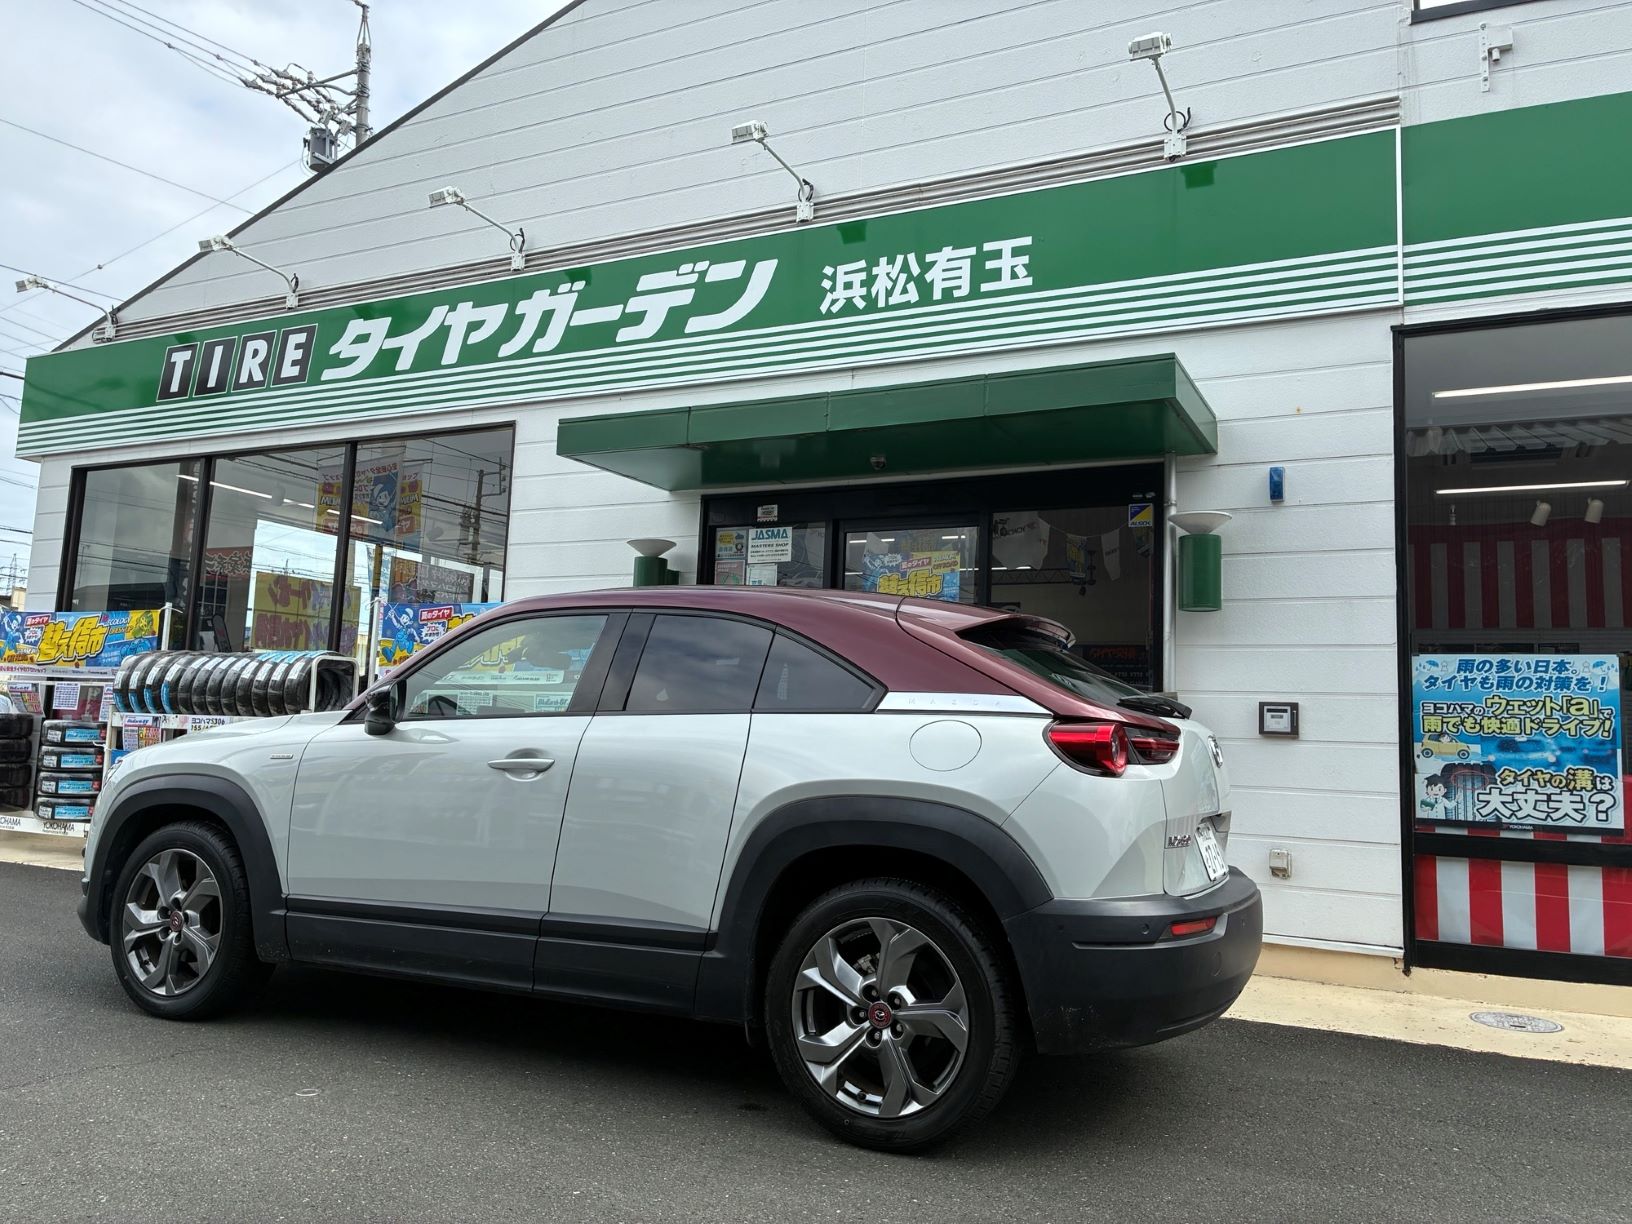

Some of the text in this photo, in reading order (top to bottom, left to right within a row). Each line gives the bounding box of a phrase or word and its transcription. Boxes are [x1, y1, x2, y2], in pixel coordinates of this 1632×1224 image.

[819, 235, 1033, 315] 浜松有玉
[320, 258, 778, 381] タイヤガーデン
[168, 333, 308, 392] TIRE
[751, 528, 789, 541] JASMA
[1456, 658, 1579, 676] 雨の多い日本。
[1423, 675, 1608, 693] タイヤも雨の対策を!
[191, 717, 226, 725] ヨコハマS306
[1421, 714, 1614, 740] 雨でも快適ドライブ!
[1498, 767, 1615, 792] タイヤの溝は
[1476, 787, 1617, 823] 大丈夫?
[43, 821, 75, 832] YOKOHAMA
